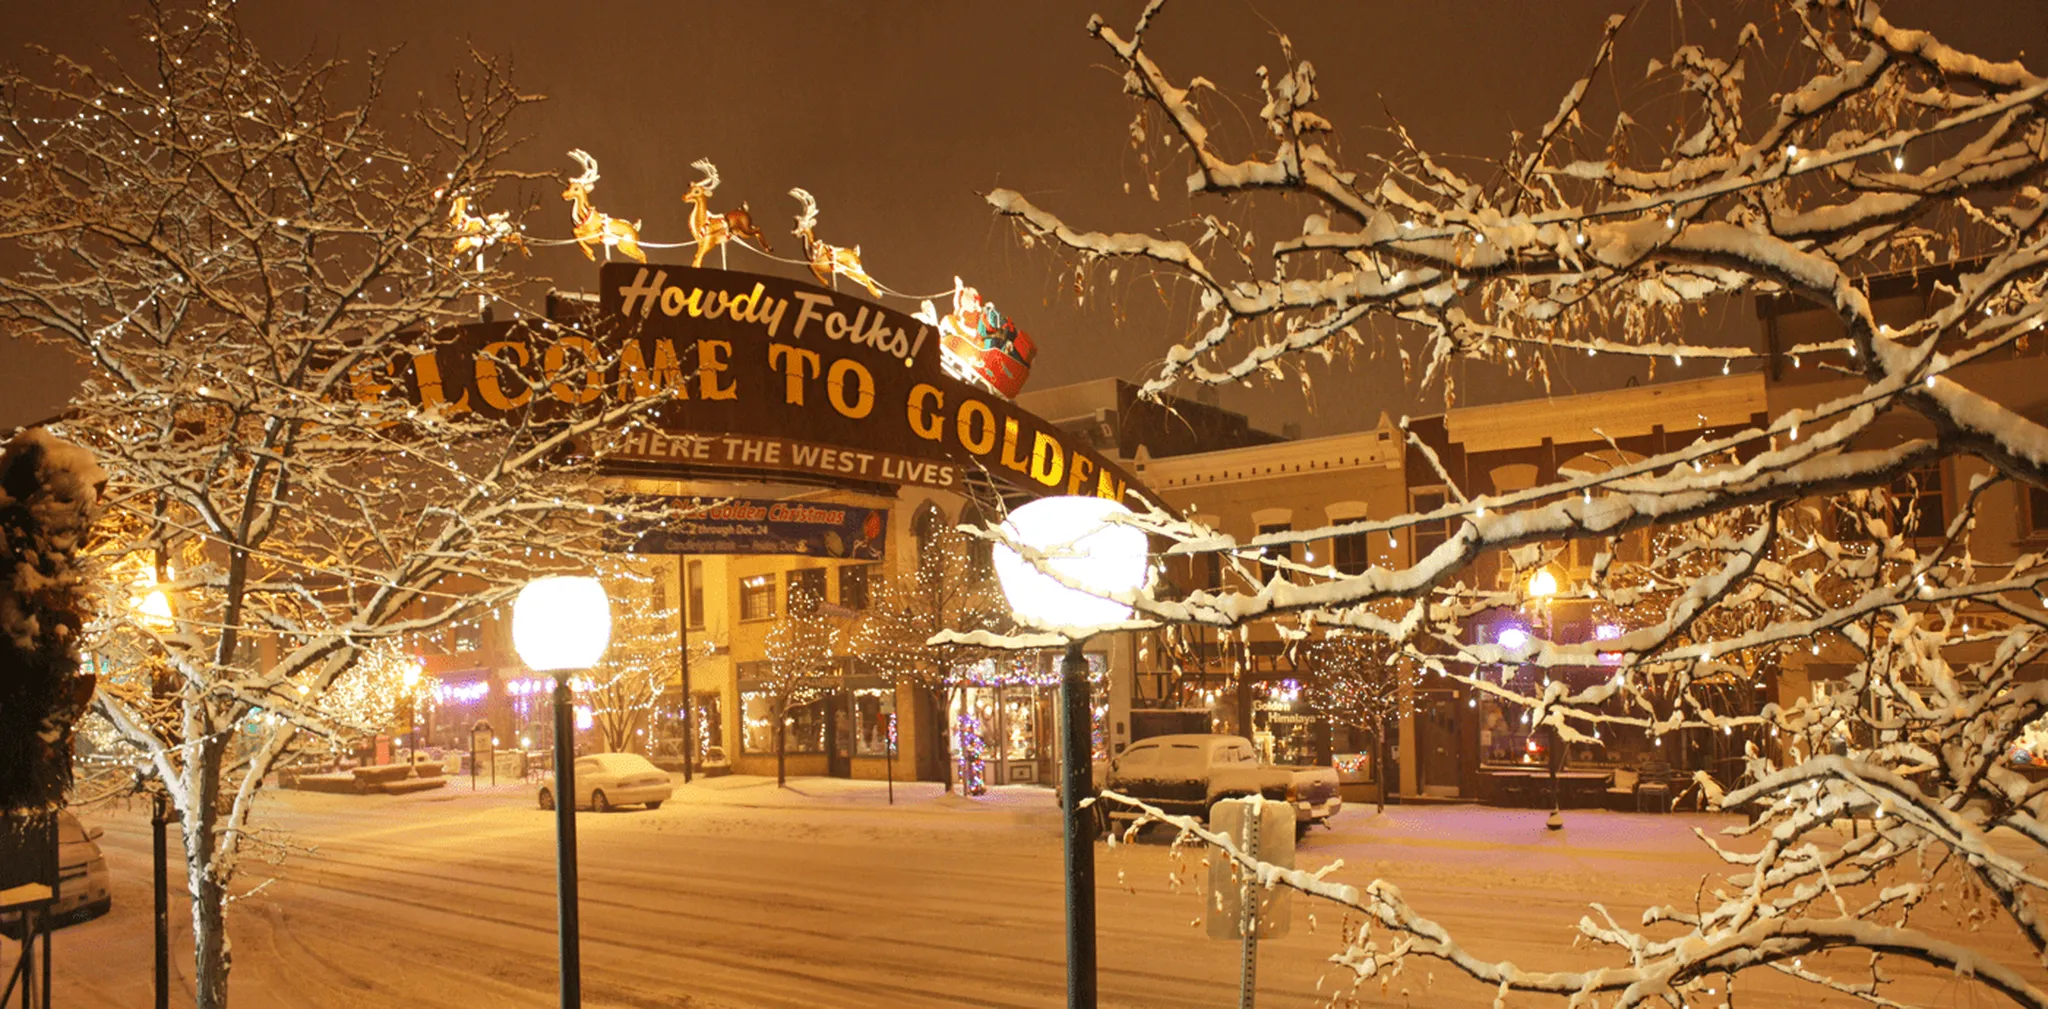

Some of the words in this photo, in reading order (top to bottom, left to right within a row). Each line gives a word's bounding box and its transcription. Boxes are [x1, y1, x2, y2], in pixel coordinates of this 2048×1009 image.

[619, 267, 789, 338] Howdy
[793, 289, 929, 368] Folks!
[768, 340, 875, 419] TO
[907, 382, 1127, 505] GOLDEN
[722, 437, 782, 464] THE
[791, 443, 874, 475] WEST
[881, 454, 955, 487] LIVES
[710, 501, 767, 520] Golden
[769, 503, 845, 525] Christmas
[698, 523, 735, 536] through
[1252, 700, 1291, 711] Golden
[1267, 711, 1316, 725] Himalaya
